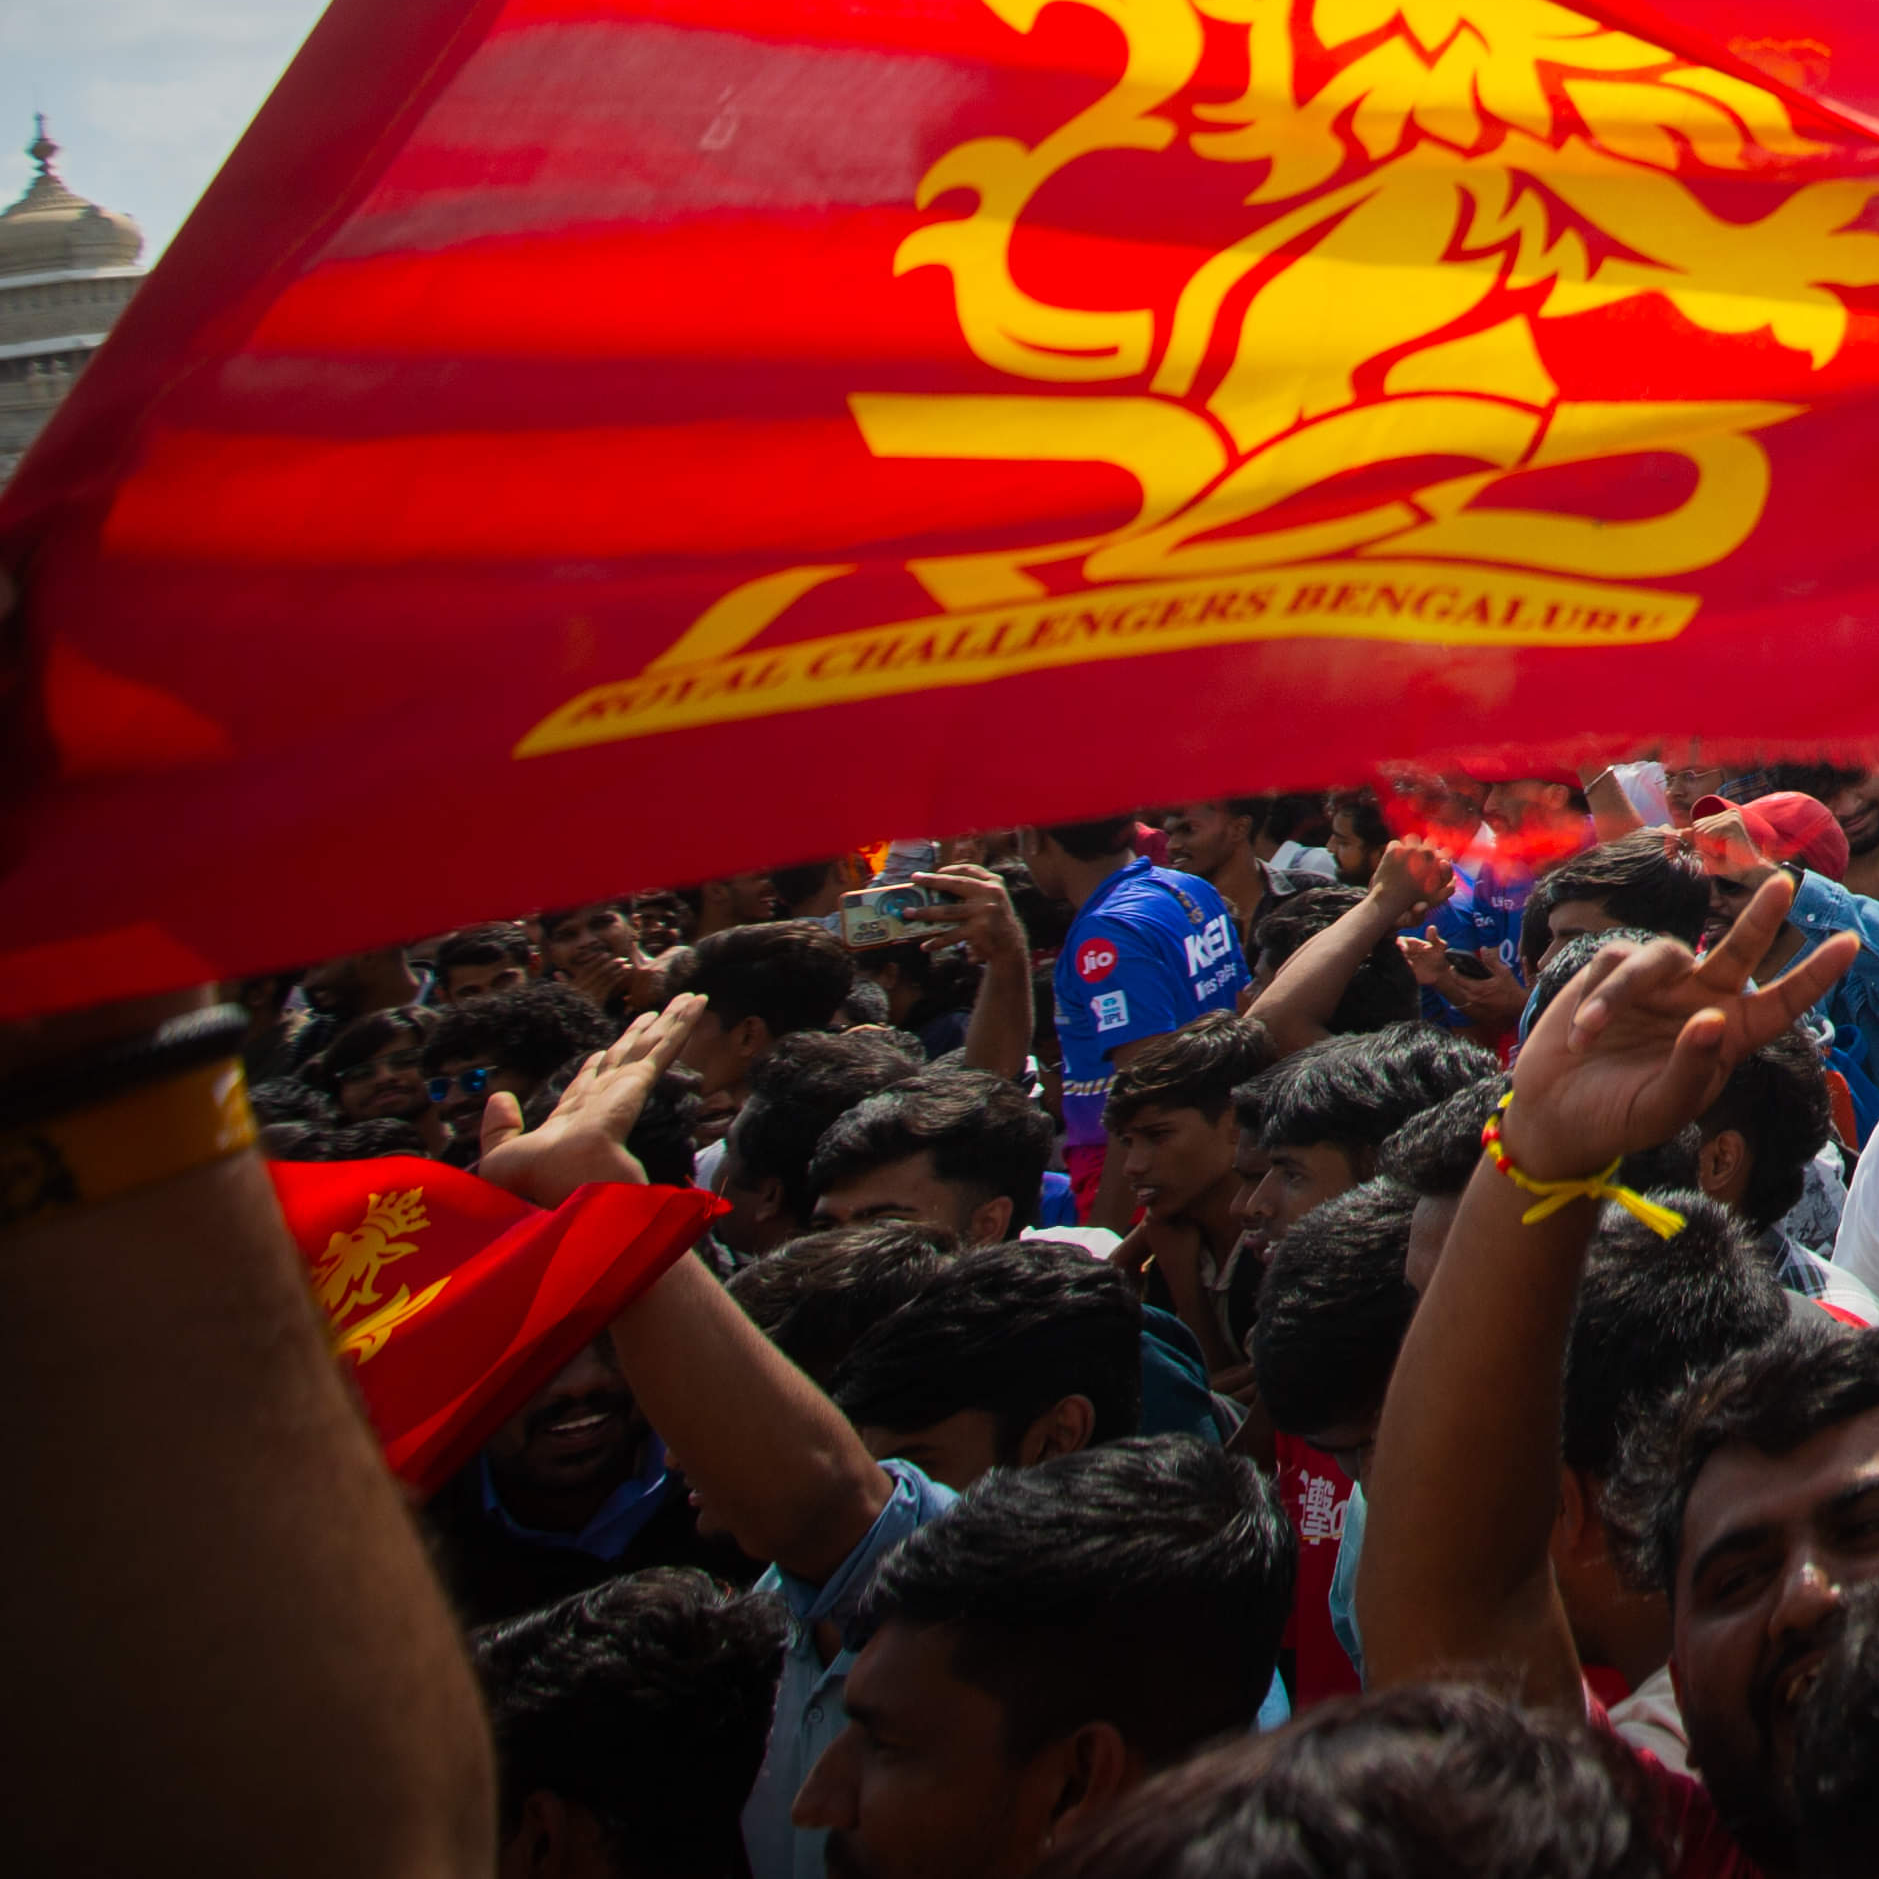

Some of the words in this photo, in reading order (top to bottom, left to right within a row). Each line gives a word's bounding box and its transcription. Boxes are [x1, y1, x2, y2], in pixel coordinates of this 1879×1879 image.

[804, 586, 1274, 680] CHALLENGERS
[1285, 581, 1668, 633] BENGALURU
[1184, 913, 1233, 978] KEI
